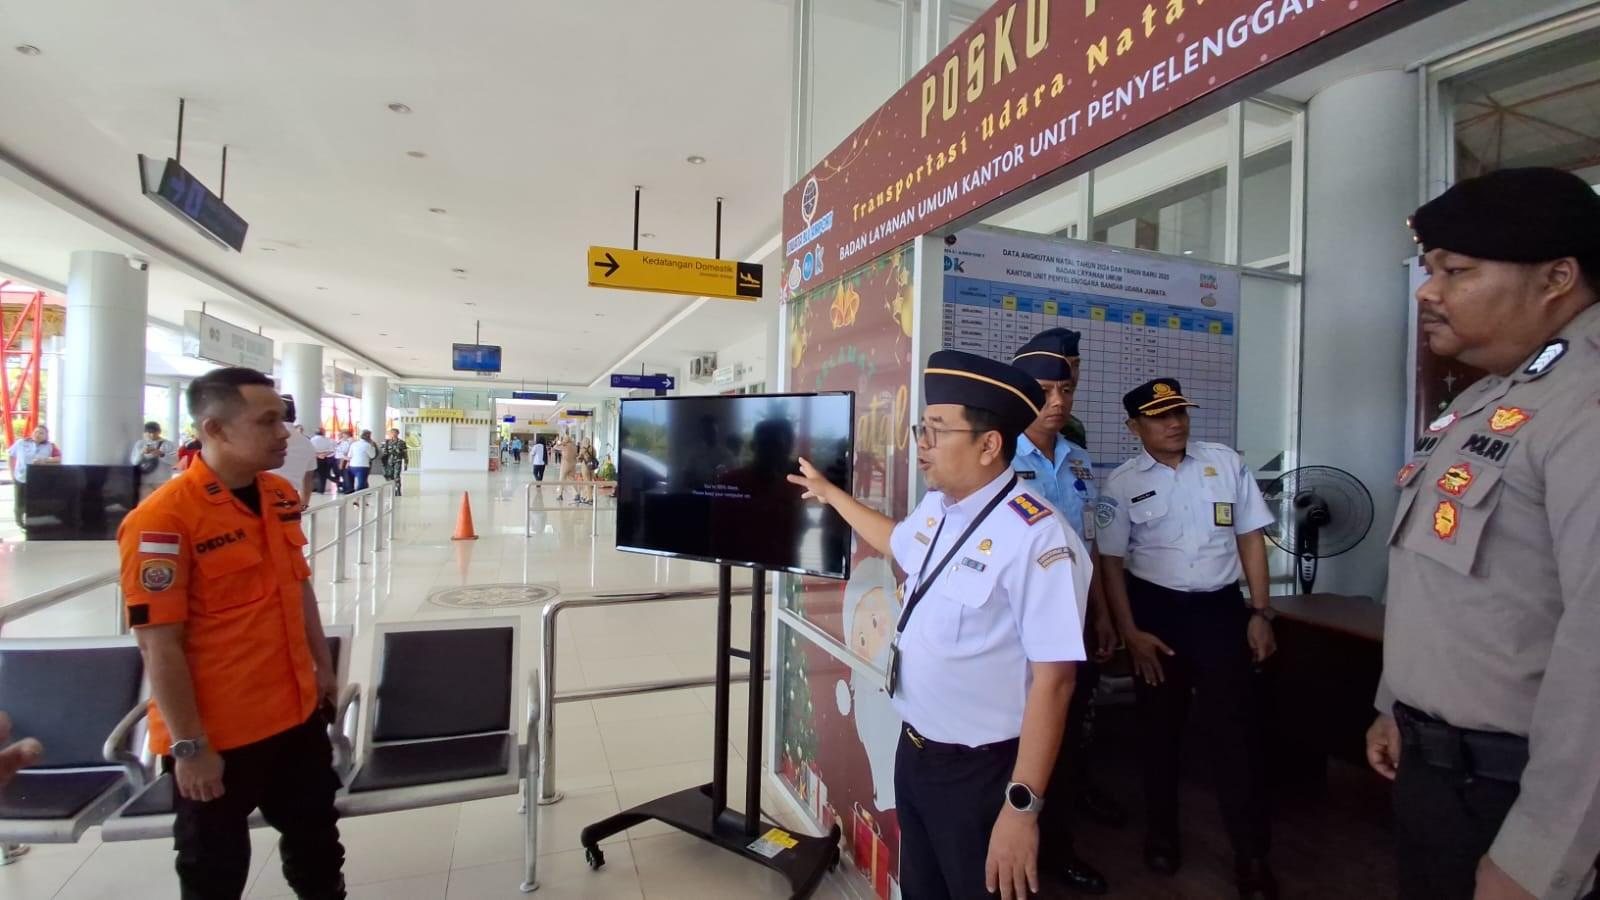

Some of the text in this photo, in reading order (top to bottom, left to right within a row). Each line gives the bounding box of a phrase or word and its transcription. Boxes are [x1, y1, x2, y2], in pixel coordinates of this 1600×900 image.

[921, 0, 1049, 138] POSKO
[852, 131, 968, 223] Transportasi
[1086, 0, 1204, 74] Nata
[839, 0, 1314, 261] BADAN LAYANAN UMUM KANTOR UNIT PENYELENGGA
[642, 255, 733, 273] Kedatangan Domestik
[1002, 248, 1020, 258] DATA
[1021, 251, 1055, 263] ANGKUTAN
[1056, 256, 1074, 266] NATAL
[1076, 259, 1095, 269] TAHUN
[1006, 268, 1032, 278] KANTOR
[1033, 271, 1047, 280] UNIT
[1048, 274, 1099, 287] PENYELENGGARA
[1056, 266, 1123, 282] BADAN LAYANAN UMUM
[1461, 433, 1510, 462] POLRI
